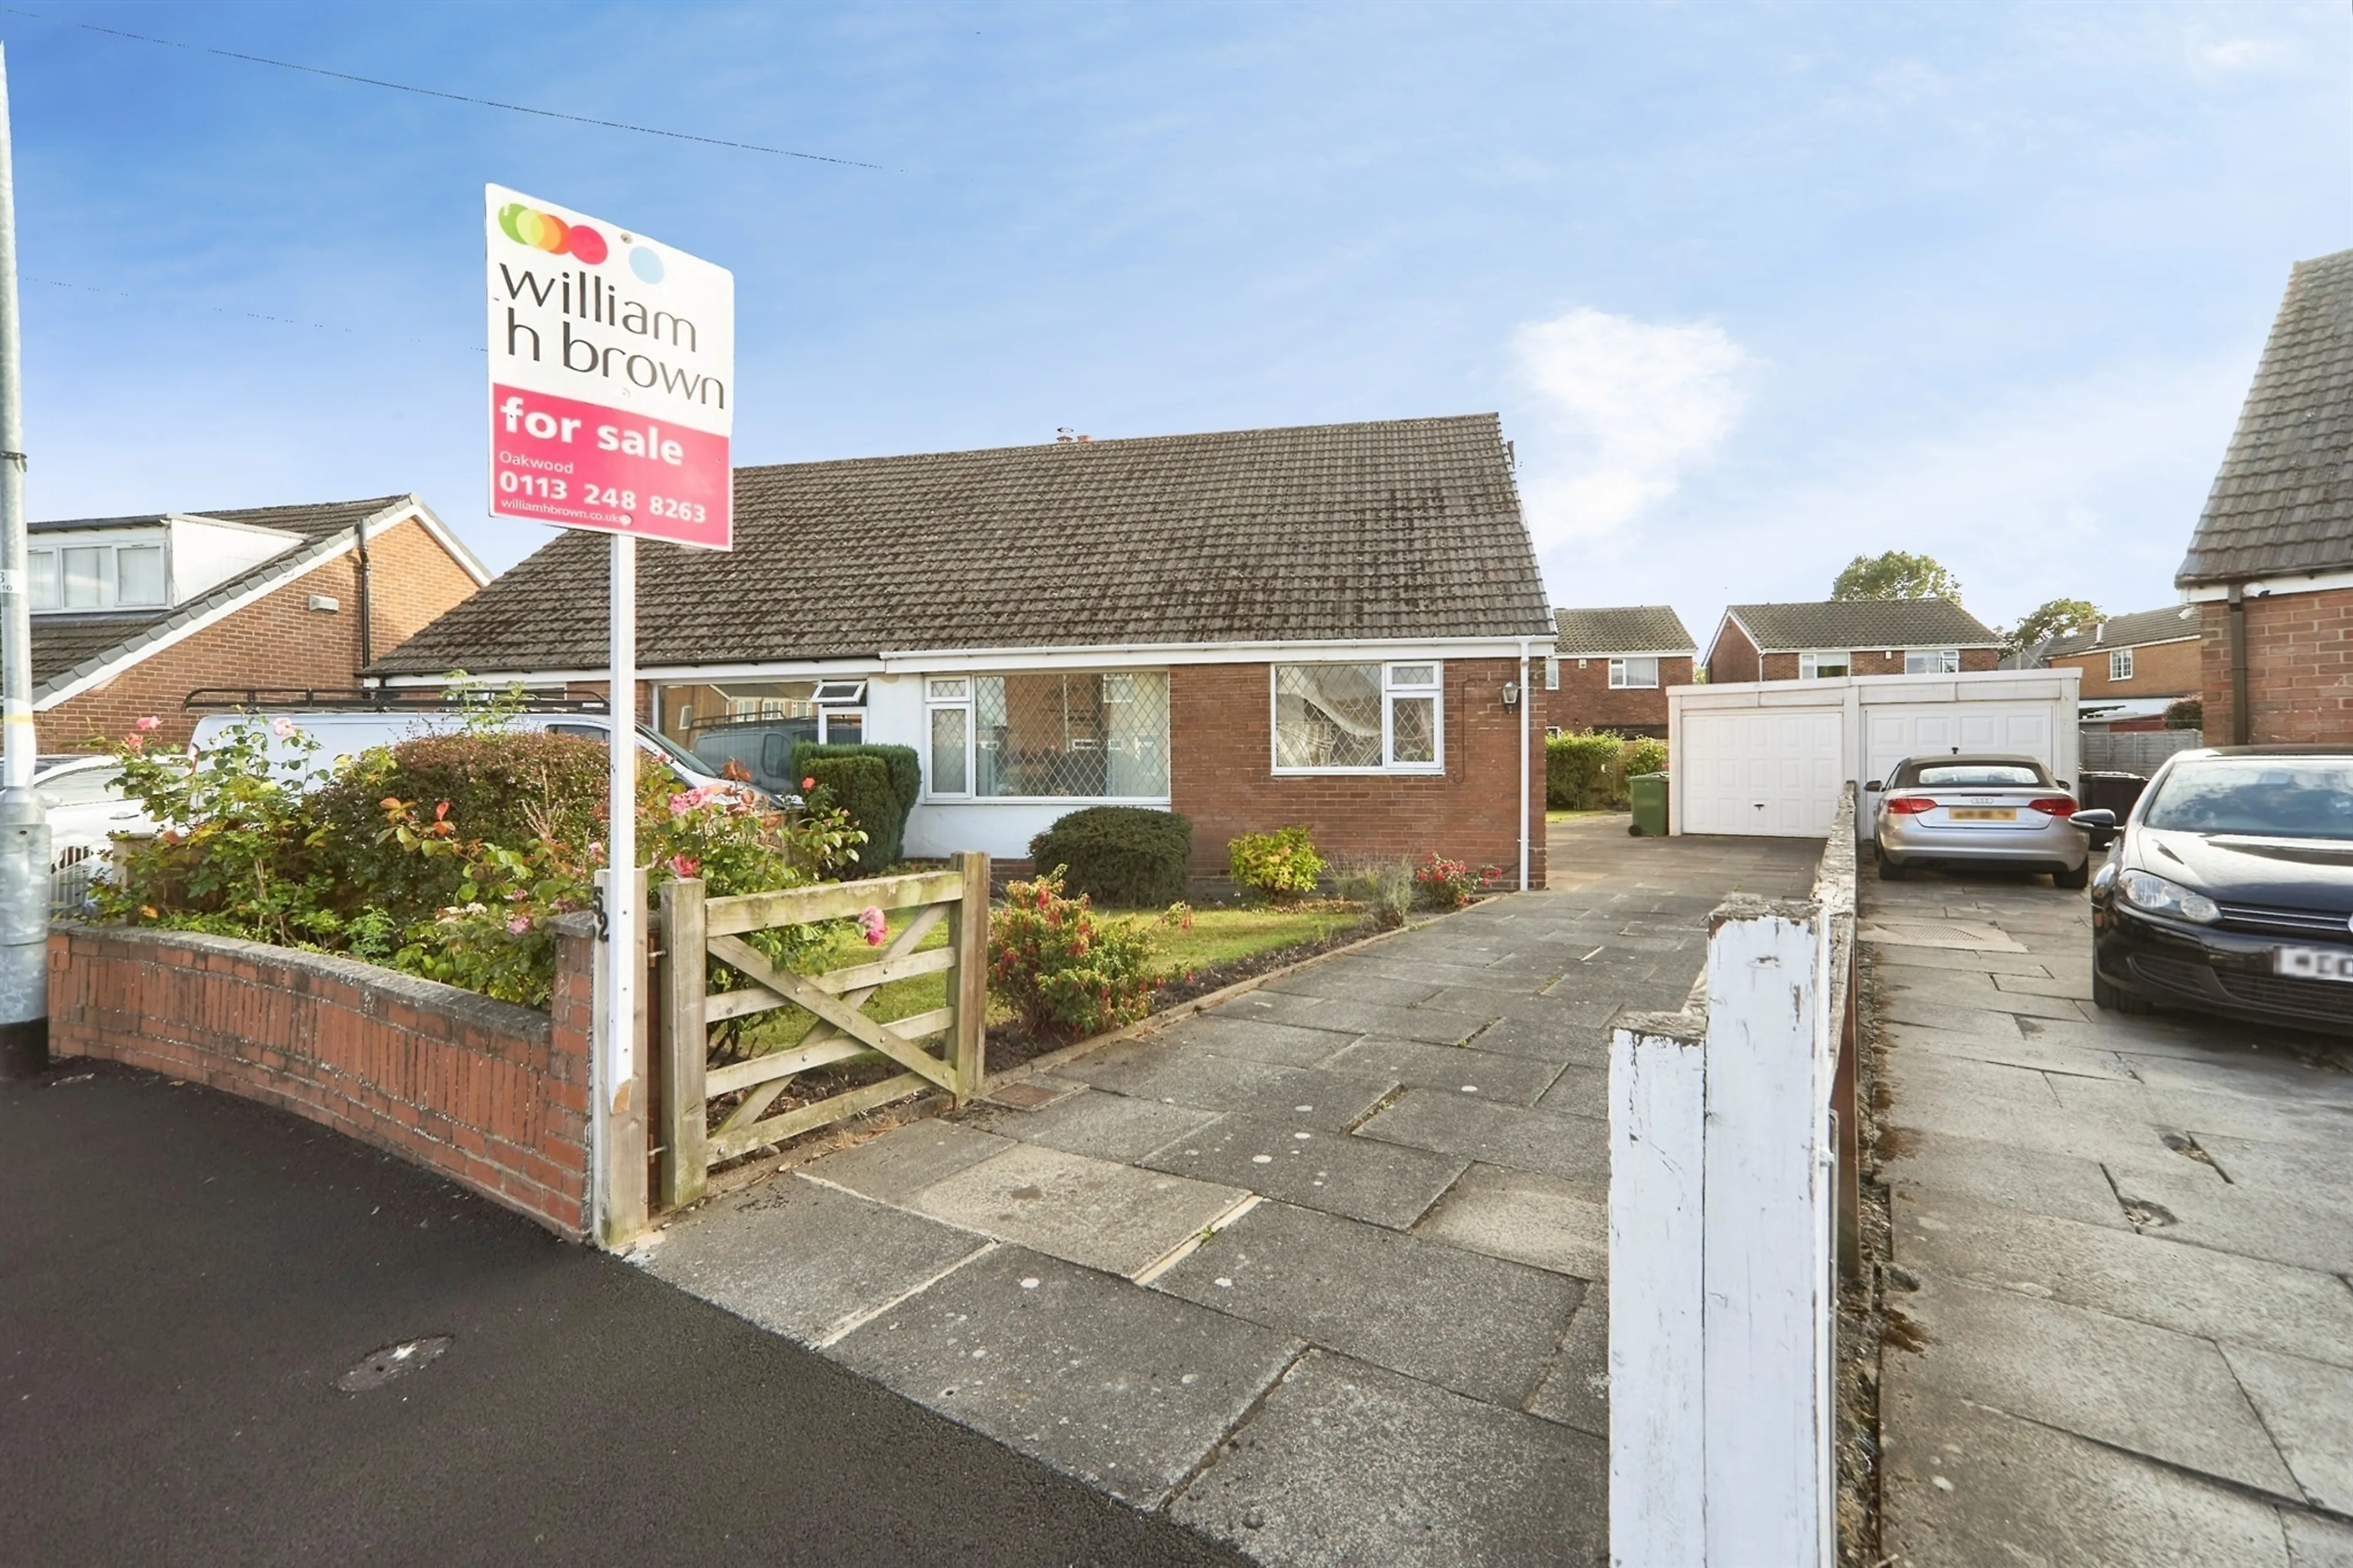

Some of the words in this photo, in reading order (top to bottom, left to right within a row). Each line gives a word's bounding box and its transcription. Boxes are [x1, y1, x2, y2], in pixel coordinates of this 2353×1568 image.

[499, 262, 697, 352] william
[507, 306, 540, 362] h
[563, 321, 724, 409] brown
[499, 396, 582, 444] for
[597, 425, 684, 466] sale
[499, 451, 574, 474] Oakwood
[499, 471, 567, 500] 0113
[583, 483, 637, 511] 248
[649, 495, 706, 524] 8263
[501, 499, 620, 523] williamhbrown.co.uk
